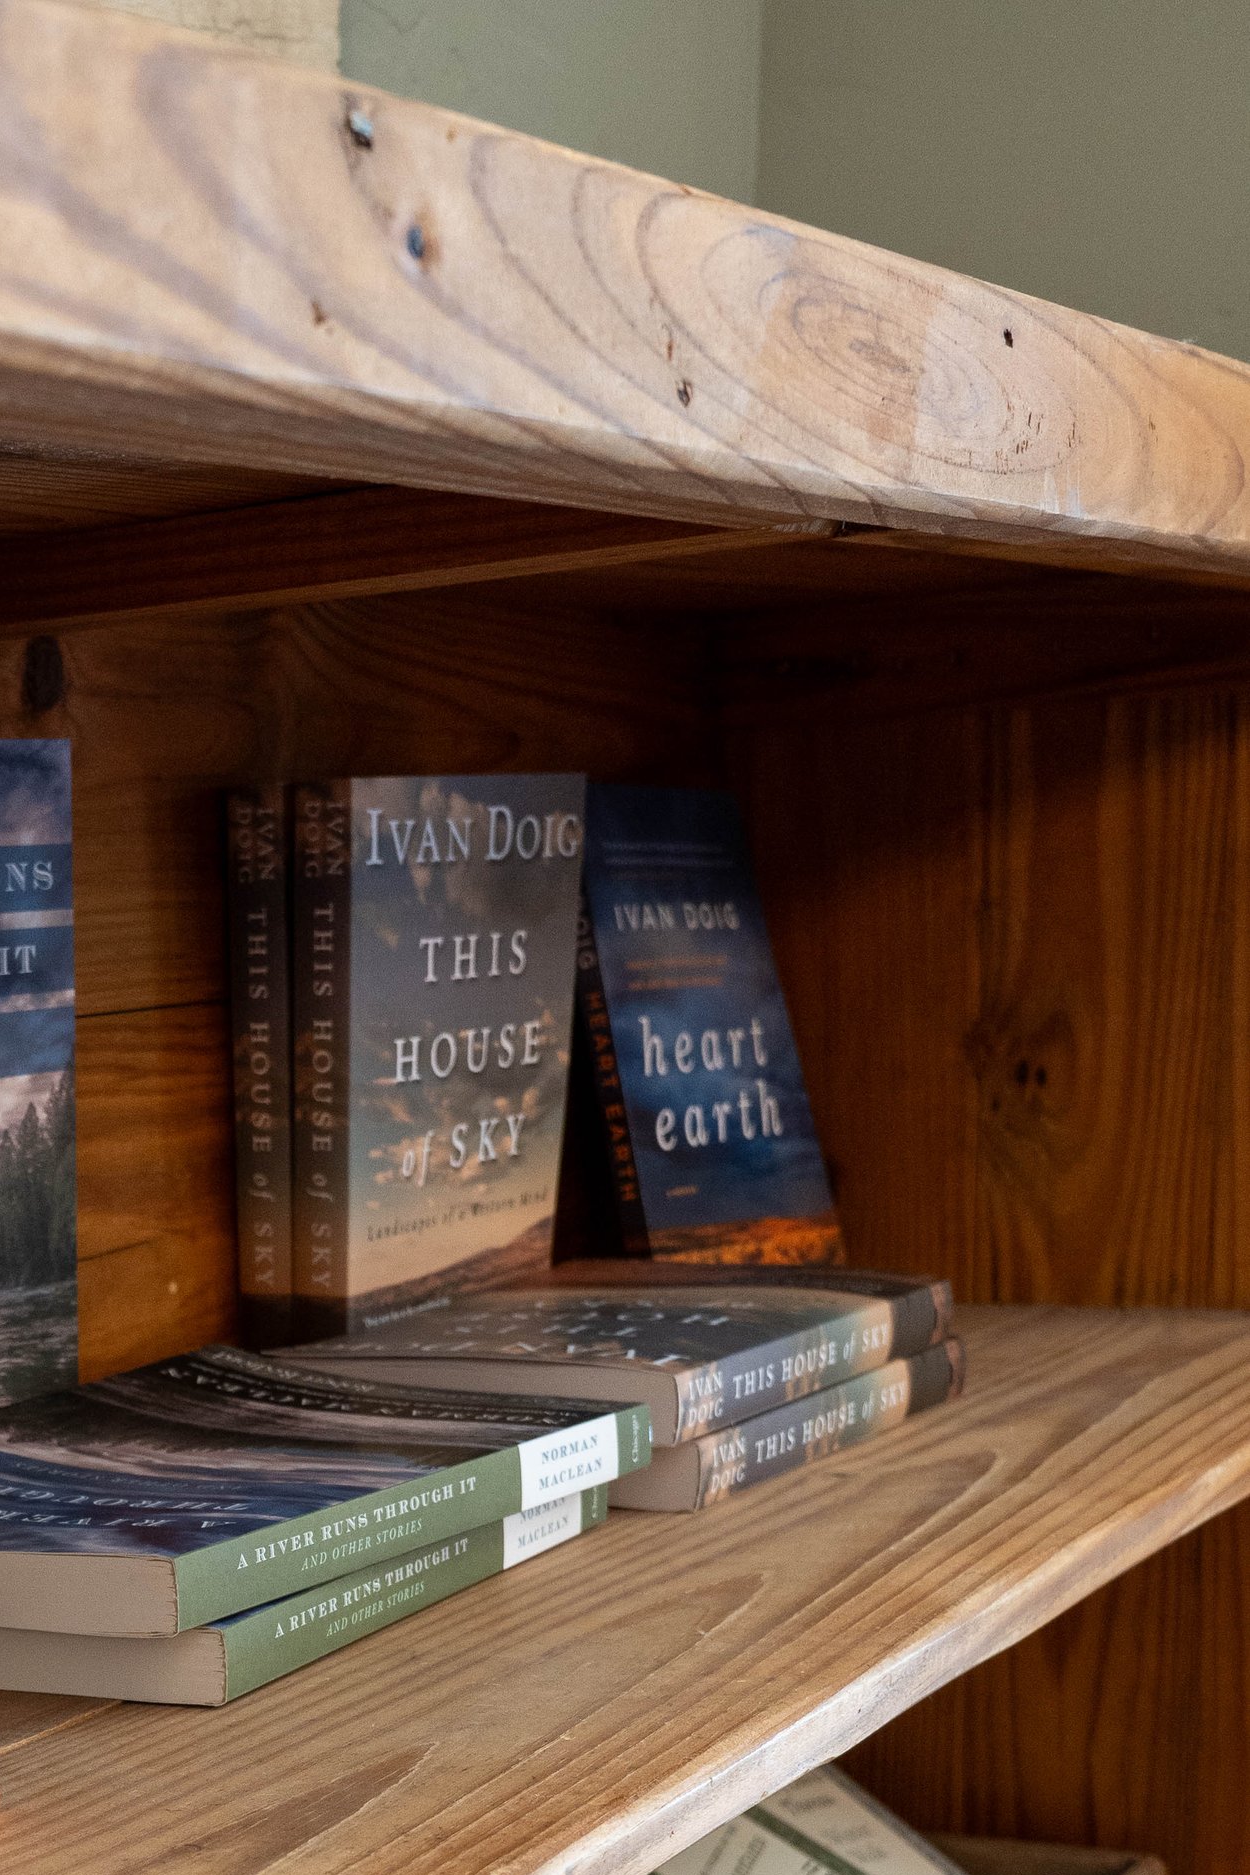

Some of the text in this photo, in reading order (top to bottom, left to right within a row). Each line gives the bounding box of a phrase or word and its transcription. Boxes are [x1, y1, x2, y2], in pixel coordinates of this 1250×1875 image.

[234, 802, 249, 884] DOIG
[256, 805, 277, 880] IVAN
[302, 799, 319, 880] DOIG
[326, 801, 345, 877] IVAN
[366, 808, 472, 867] IVAN
[485, 804, 580, 862] DOIG
[613, 900, 740, 930] IVAN DOIG
[419, 929, 528, 983] THIS
[394, 1020, 542, 1083] HOUSE
[638, 1014, 769, 1078] heart
[248, 907, 275, 1287] THIS HOUSE of SKY
[307, 901, 336, 1288] THIS HOUSE of SKY
[654, 1078, 785, 1152] earth
[401, 1112, 526, 1186] of SKY
[686, 1371, 724, 1400] IVAN
[732, 1323, 889, 1400] THIS HOUSE of SKY
[687, 1397, 725, 1428] DOIG
[754, 1380, 908, 1463] THIS HOUSE of SKY
[538, 1457, 604, 1491] MACLEAN
[541, 1434, 599, 1464] NORMAN
[710, 1437, 747, 1468] IVAN
[710, 1463, 746, 1495] DOIG
[237, 1476, 477, 1570] A RIVER RUNS THROUGH IT
[301, 1518, 423, 1571] AND OTHER STORIES
[517, 1514, 569, 1548] MACLEAN
[274, 1537, 469, 1639] A RIVER RUNS THROUGH IT
[326, 1580, 425, 1637] AND OTHER STORIES
